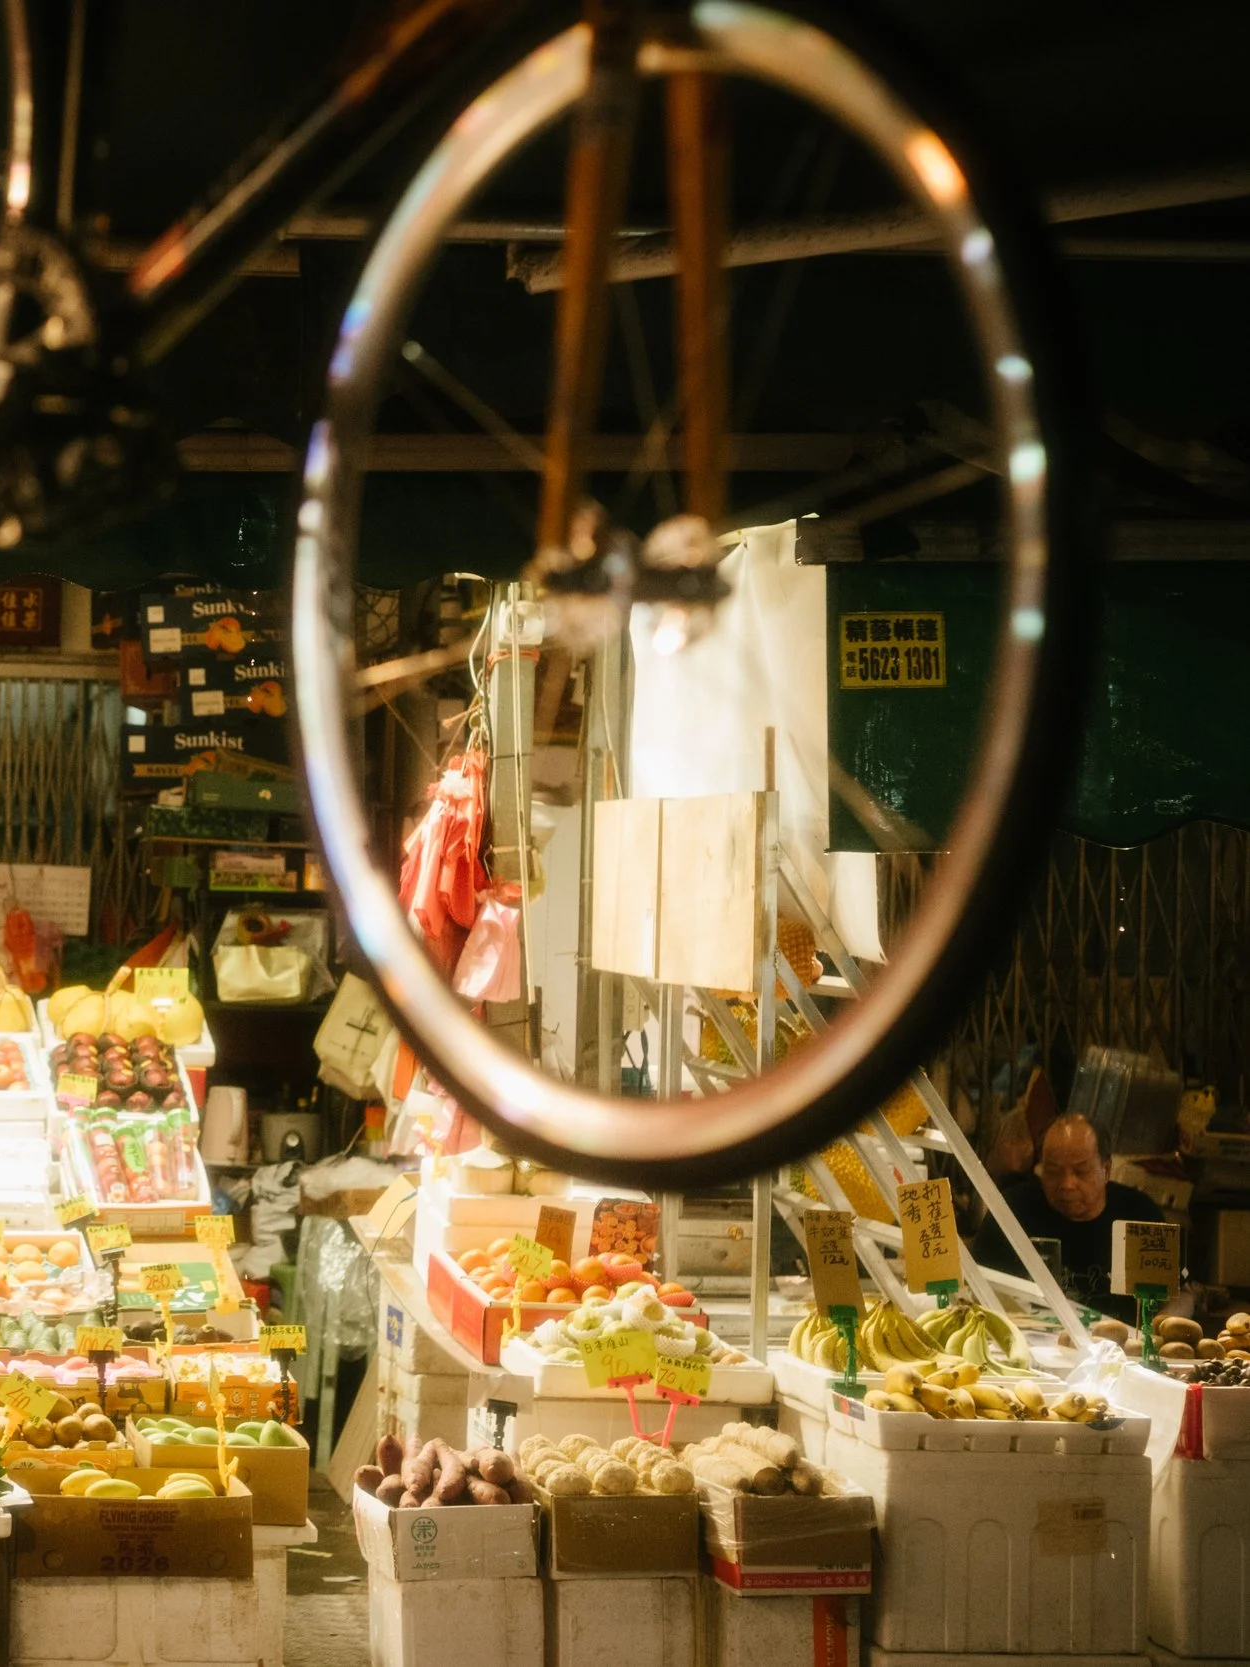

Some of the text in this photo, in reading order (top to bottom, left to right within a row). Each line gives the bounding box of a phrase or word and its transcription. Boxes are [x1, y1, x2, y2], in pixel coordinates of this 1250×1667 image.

[858, 646, 941, 681] 5623 1381
[174, 731, 244, 750] Sunkist
[99, 1510, 177, 1523] FLYING HORSE
